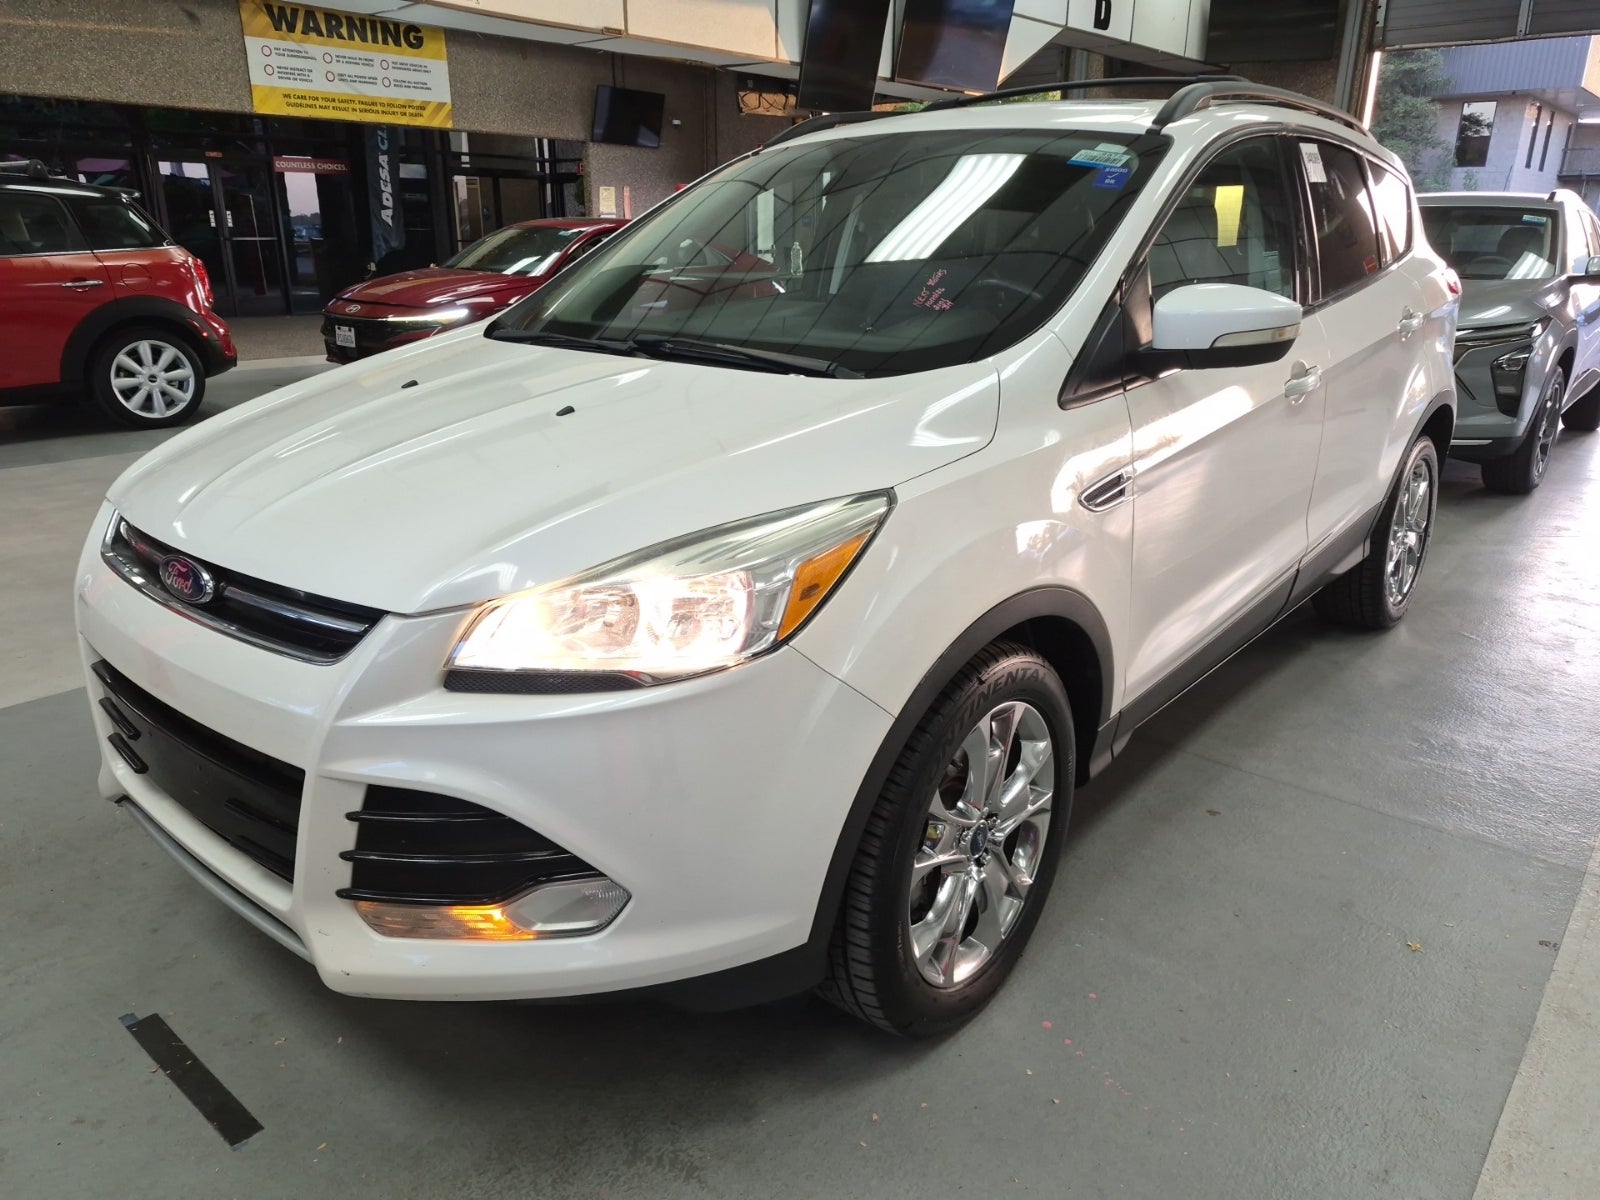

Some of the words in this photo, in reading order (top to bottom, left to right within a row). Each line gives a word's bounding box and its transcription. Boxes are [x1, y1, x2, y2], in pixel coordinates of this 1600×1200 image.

[263, 3, 424, 50] WARNING
[1093, 0, 1112, 30] D
[285, 101, 318, 110] GUIDELINES
[387, 102, 407, 110] FOLLOW
[275, 160, 316, 170] COUNTLESS
[316, 162, 348, 171] CHOICES.
[378, 154, 394, 227] ADESA
[165, 560, 194, 595] Ford
